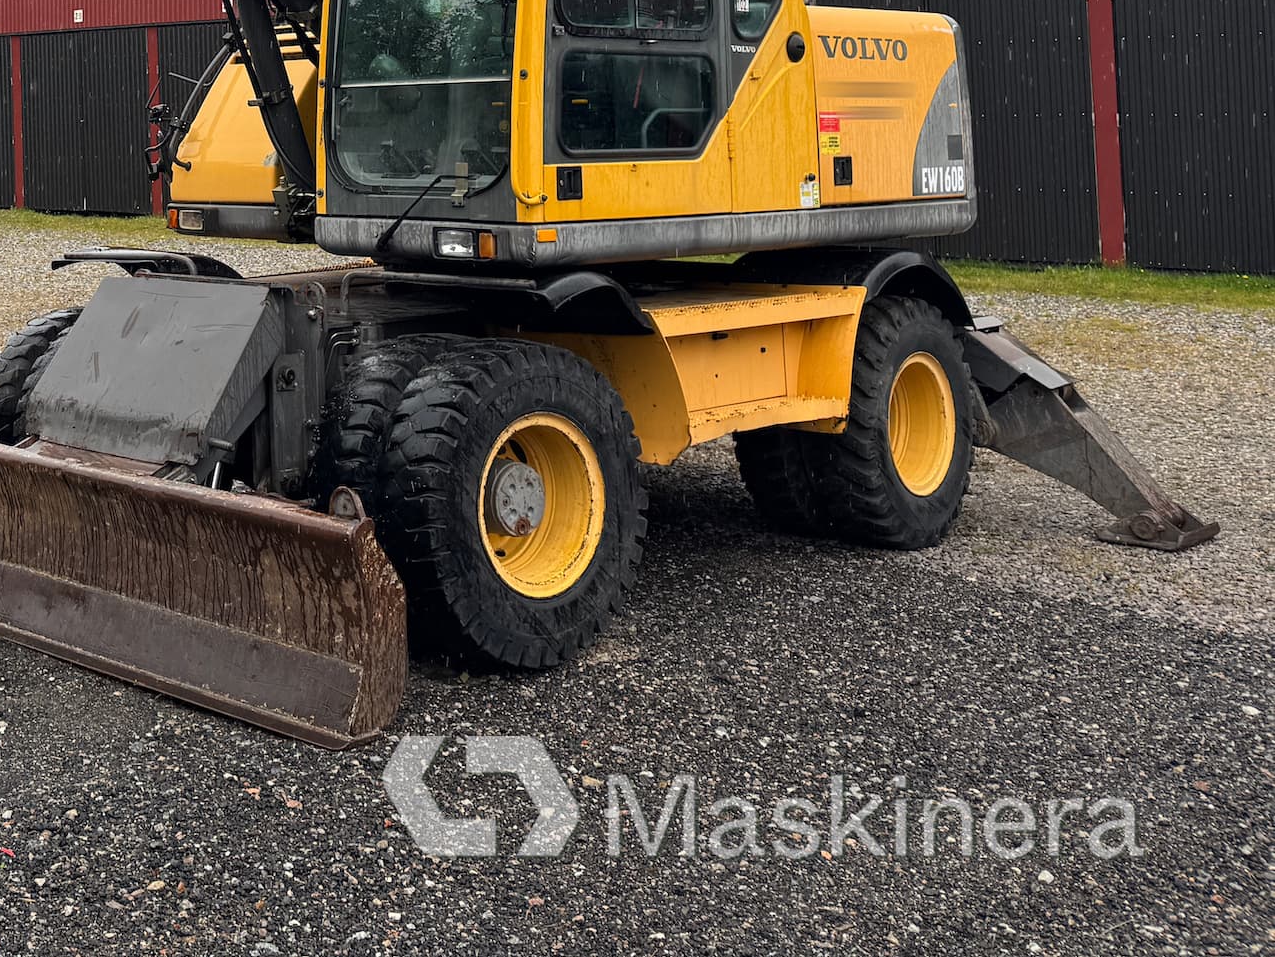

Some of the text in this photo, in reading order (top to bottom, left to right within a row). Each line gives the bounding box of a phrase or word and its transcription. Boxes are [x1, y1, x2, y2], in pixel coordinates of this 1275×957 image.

[731, 44, 757, 54] VOLVO
[817, 35, 908, 61] VOLVO
[921, 166, 965, 194] EW160B
